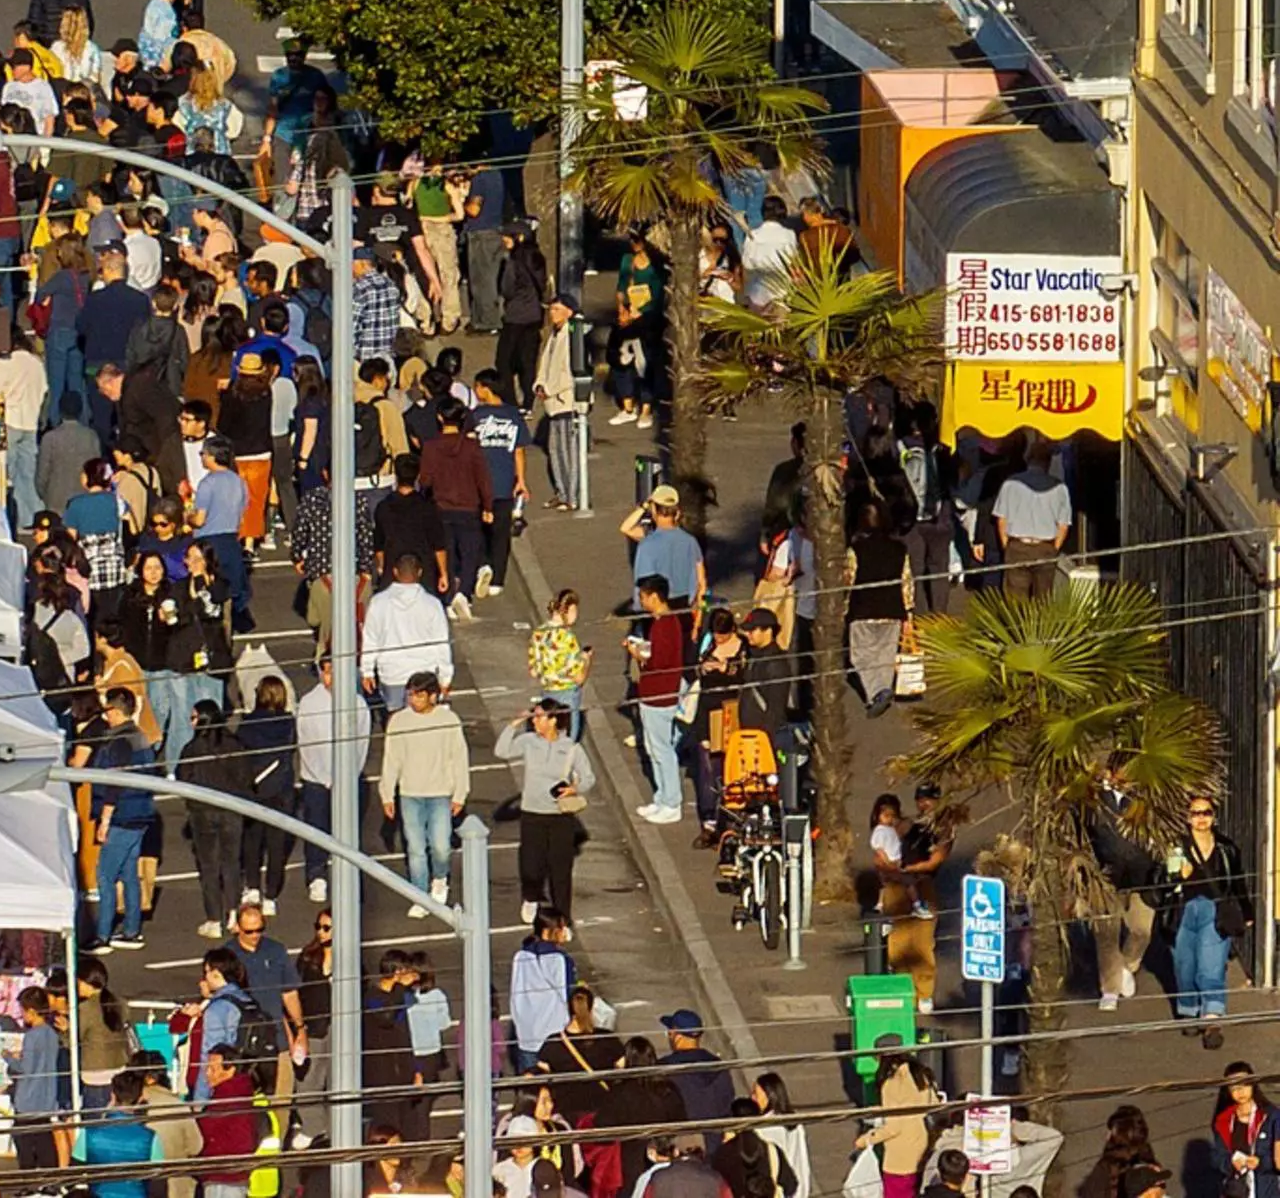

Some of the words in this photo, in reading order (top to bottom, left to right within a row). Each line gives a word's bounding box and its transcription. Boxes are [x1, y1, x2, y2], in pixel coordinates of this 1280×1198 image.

[990, 267, 1030, 291] Star
[1035, 267, 1104, 292] Vacatio
[957, 258, 988, 356] 星假期
[990, 304, 1115, 324] 415-681-1838
[980, 369, 1077, 413] 星假期
